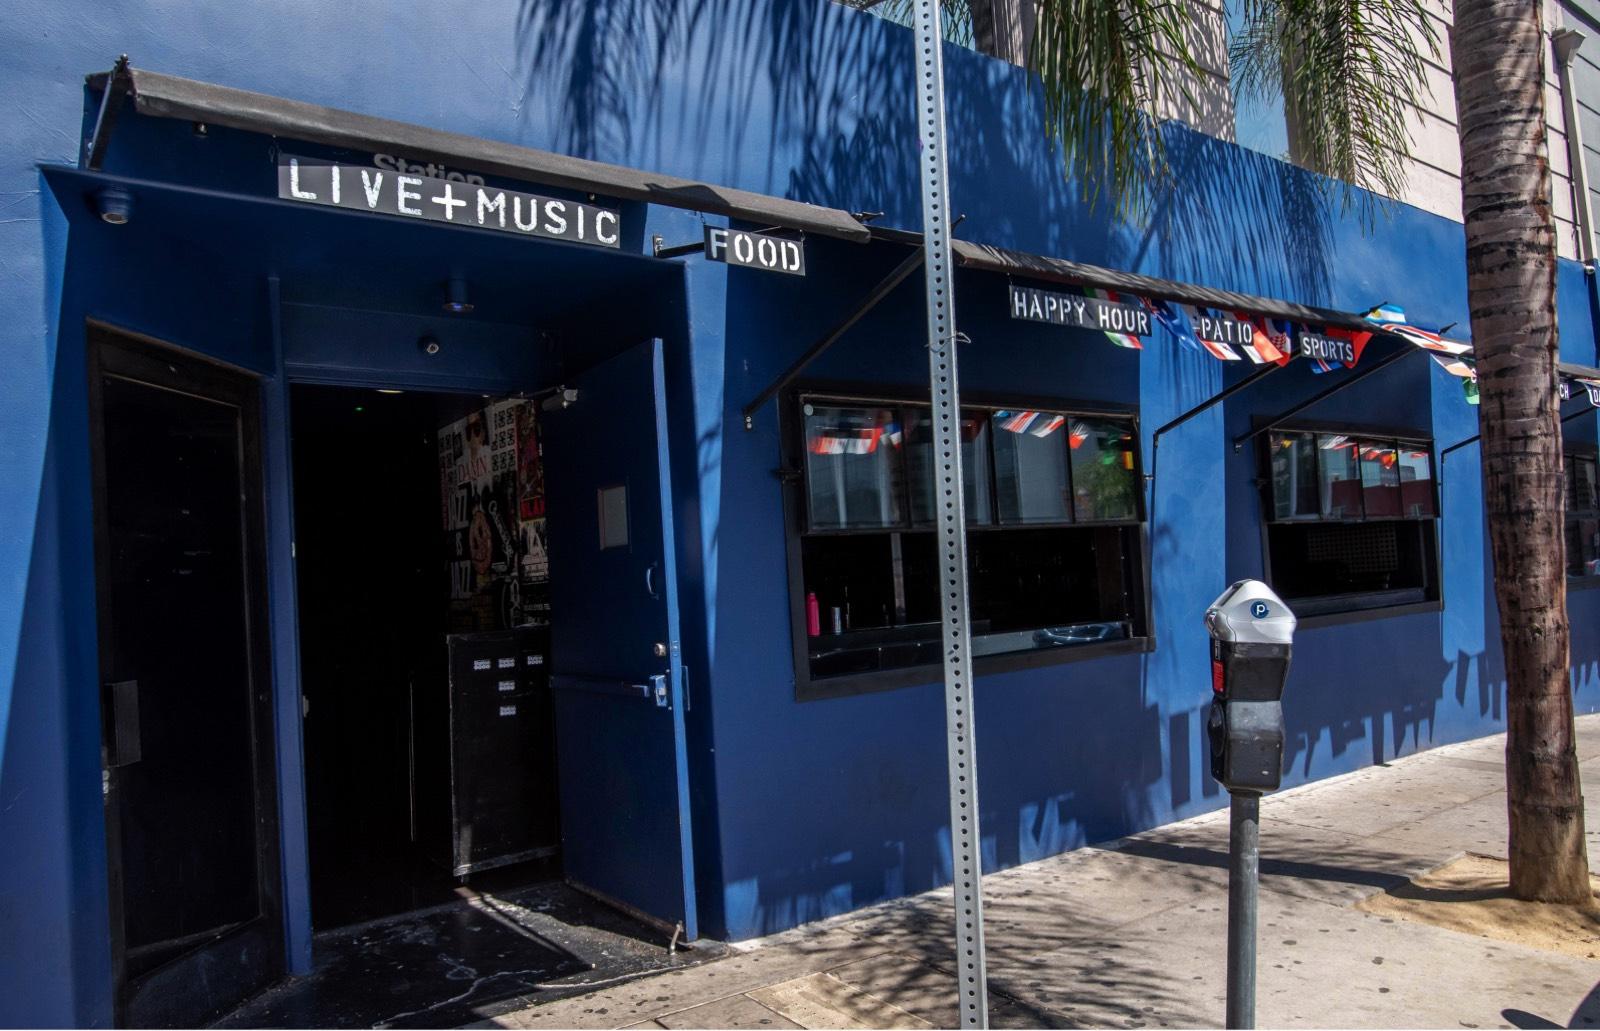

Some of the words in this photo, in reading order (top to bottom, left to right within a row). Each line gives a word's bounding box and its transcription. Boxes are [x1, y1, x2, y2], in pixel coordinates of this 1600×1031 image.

[711, 228, 801, 272] FOOD
[1014, 290, 1086, 325] HAPPY
[1097, 304, 1150, 335] HOUR
[1201, 317, 1253, 345] PATIO
[1303, 336, 1354, 362] SPORTS
